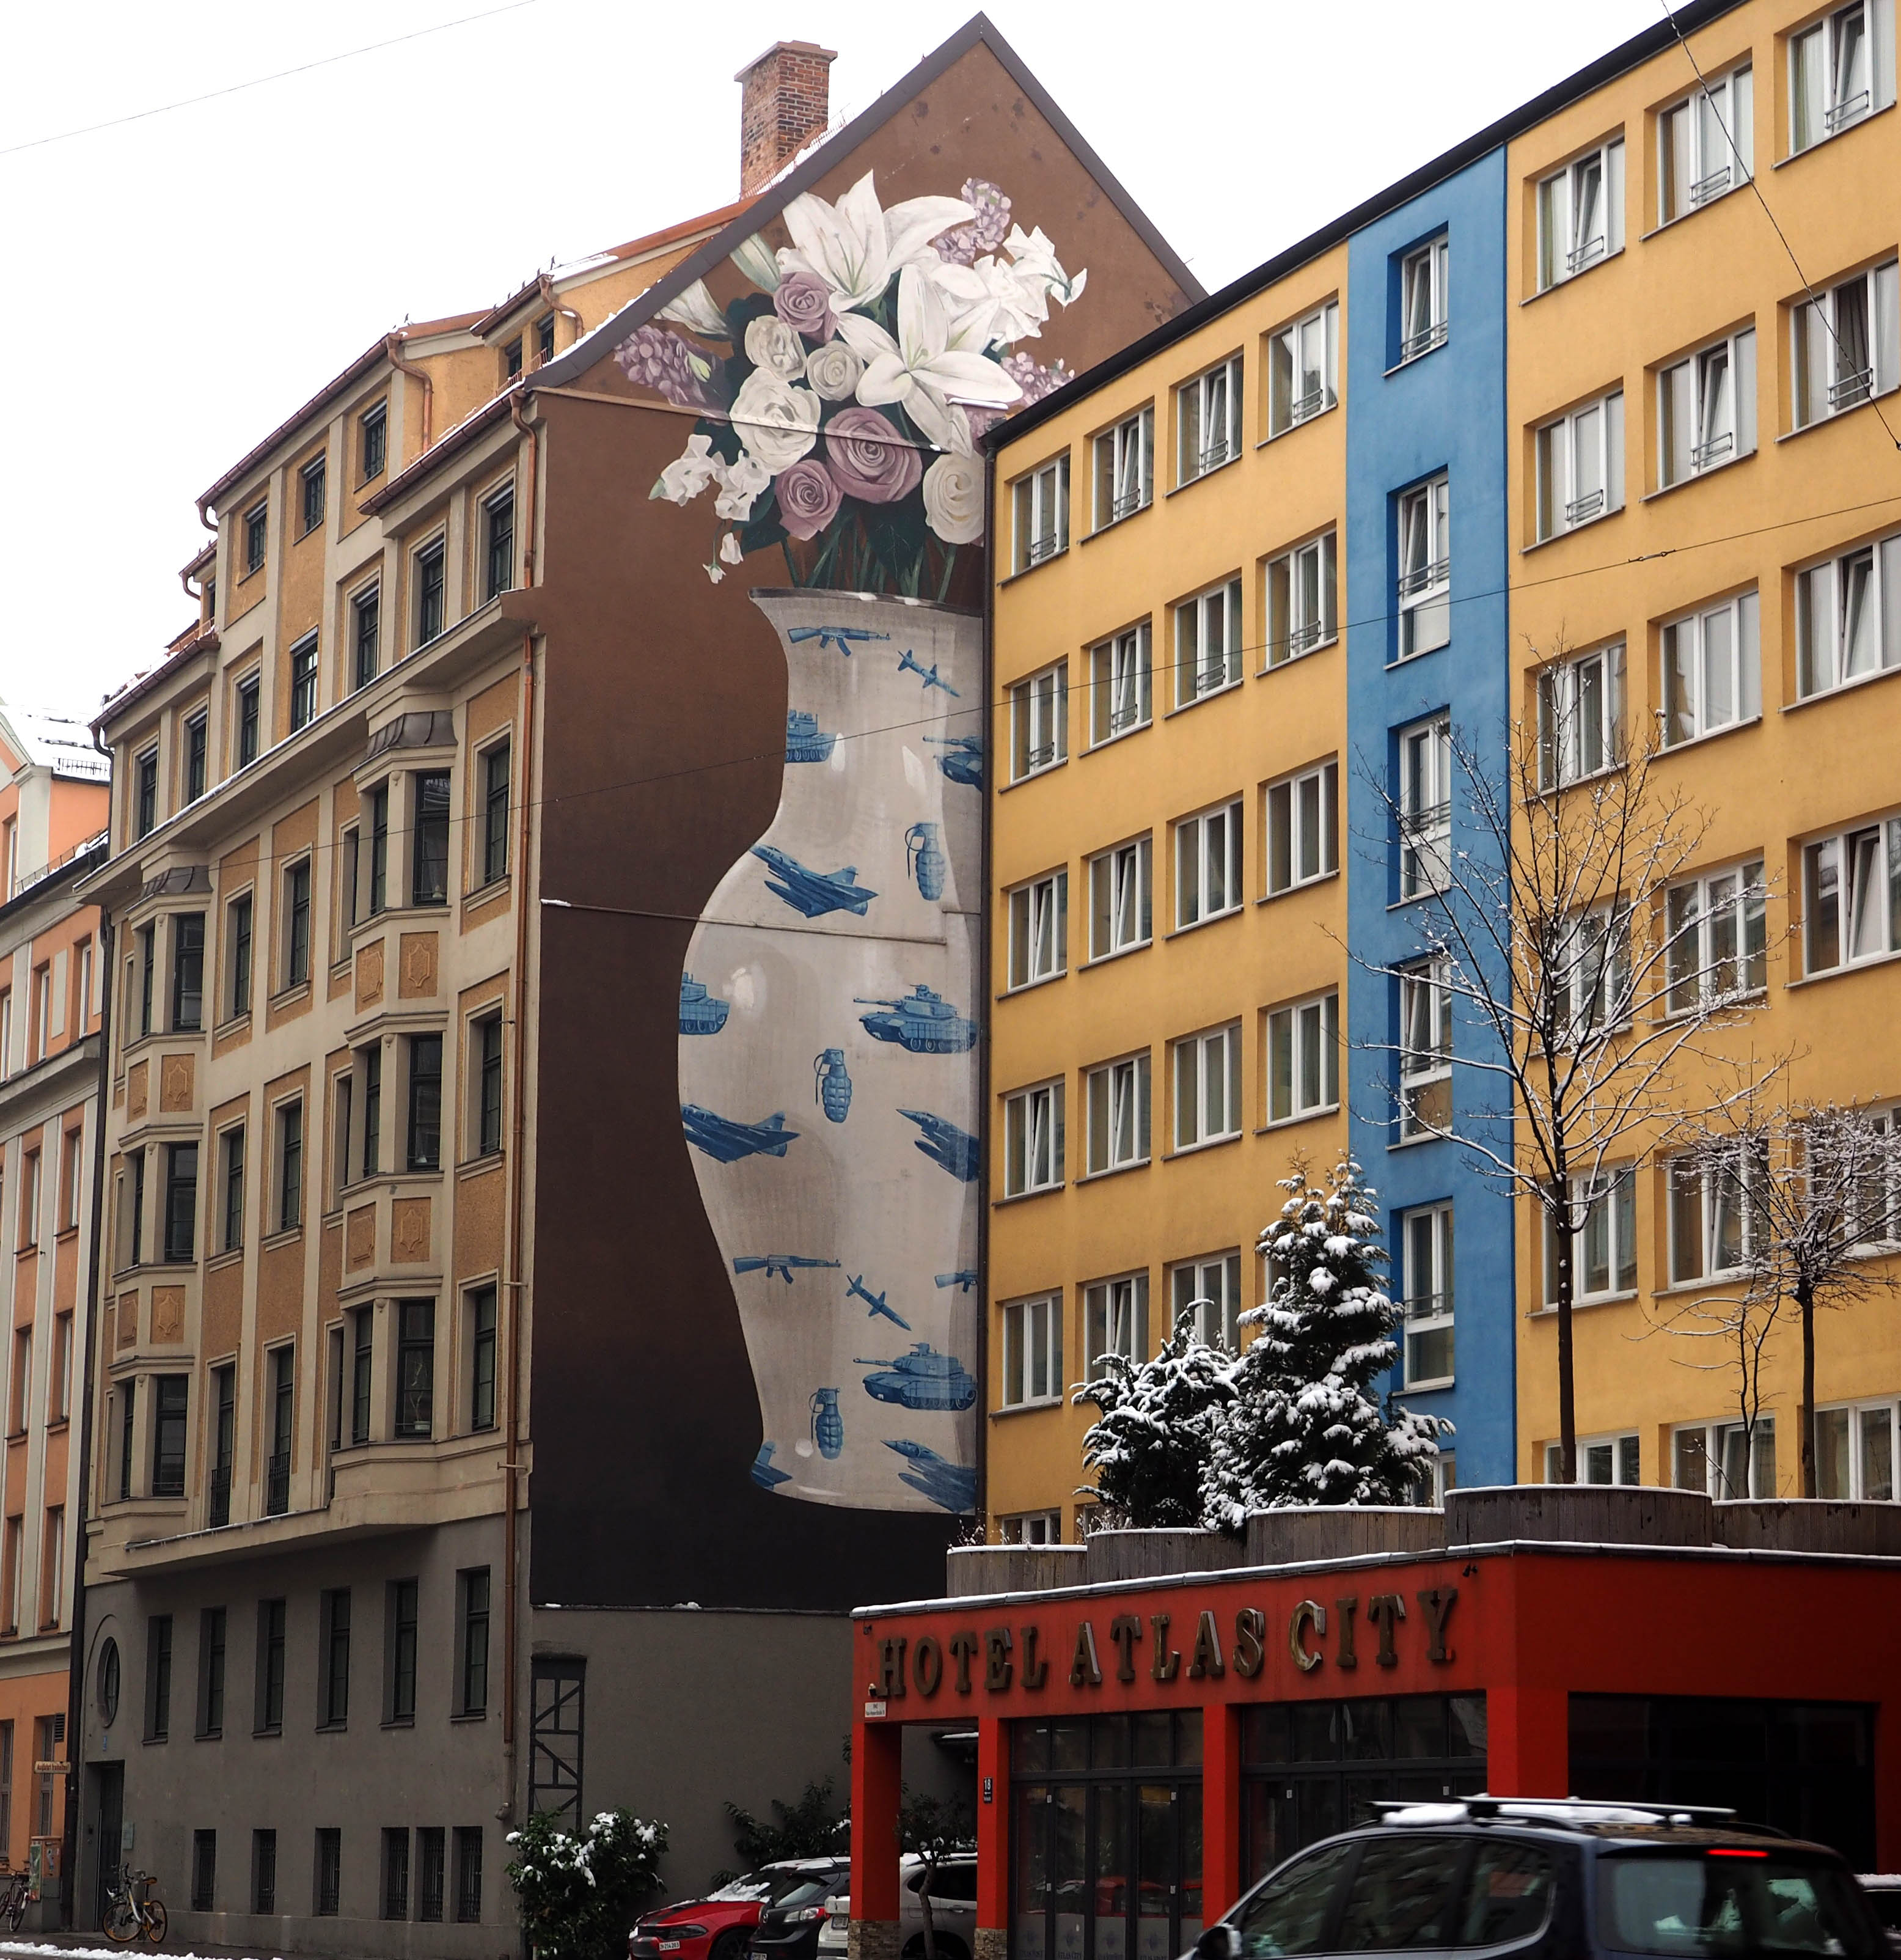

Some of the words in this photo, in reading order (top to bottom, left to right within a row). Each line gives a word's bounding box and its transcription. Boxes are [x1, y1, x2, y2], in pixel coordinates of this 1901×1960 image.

[877, 1626, 1047, 1697] HOTEL
[1069, 1607, 1265, 1684] ATLAS
[1289, 1589, 1459, 1672] CITY
[984, 1778, 991, 1790] 18
